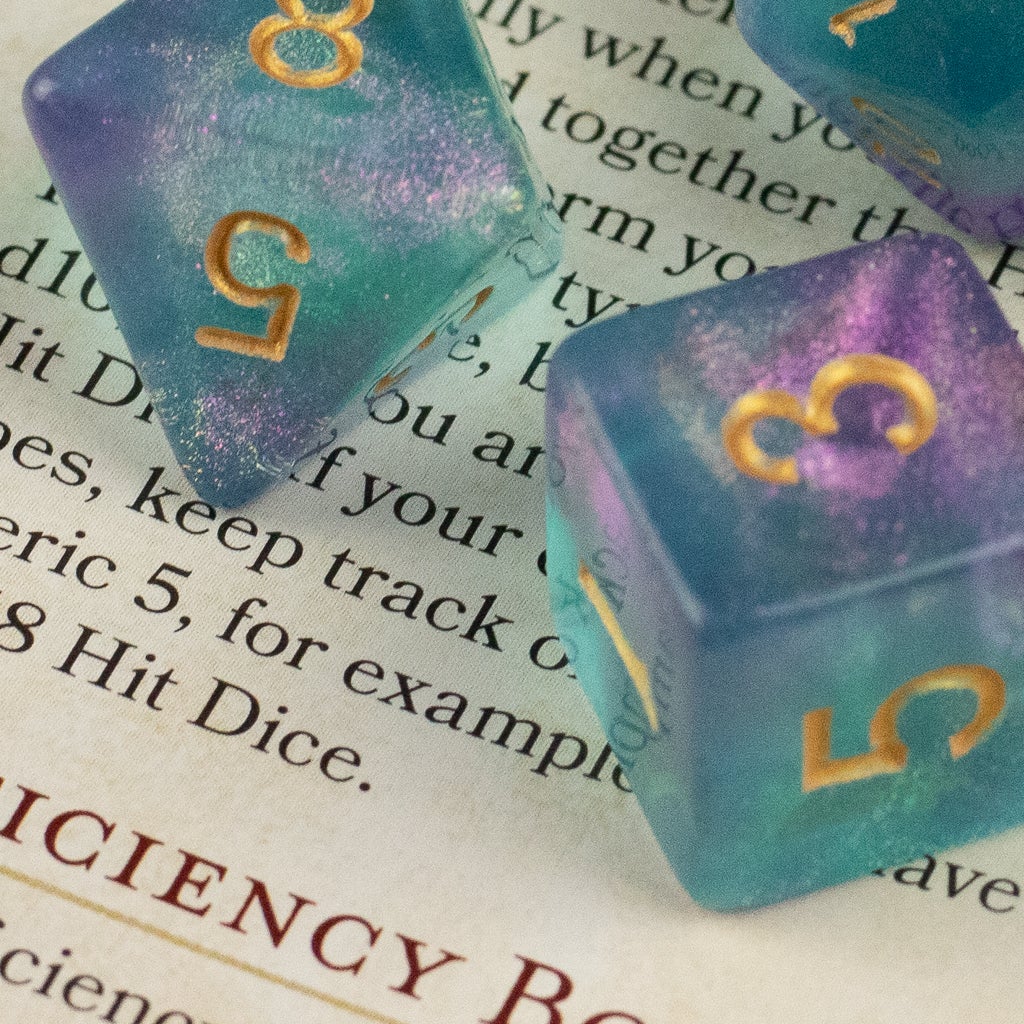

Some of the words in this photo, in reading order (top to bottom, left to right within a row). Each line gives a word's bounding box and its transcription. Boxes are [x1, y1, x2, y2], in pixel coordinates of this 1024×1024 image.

[581, 25, 763, 120] when
[540, 93, 838, 226] together
[549, 184, 655, 253] rm
[195, 210, 312, 363] 5
[551, 271, 642, 328] ty
[72, 350, 156, 425] D
[288, 446, 357, 491] f
[340, 472, 524, 558] your
[366, 388, 458, 447] ou
[721, 353, 938, 485] 3
[126, 466, 304, 575] keep
[323, 548, 515, 654] track
[529, 635, 578, 680] o
[52, 623, 179, 711] Hit
[187, 676, 371, 793] Dice.
[133, 562, 193, 633] 5,
[216, 598, 329, 670] for
[872, 853, 1021, 914] ave
[801, 663, 1007, 794] 5
[479, 953, 647, 1024] B
